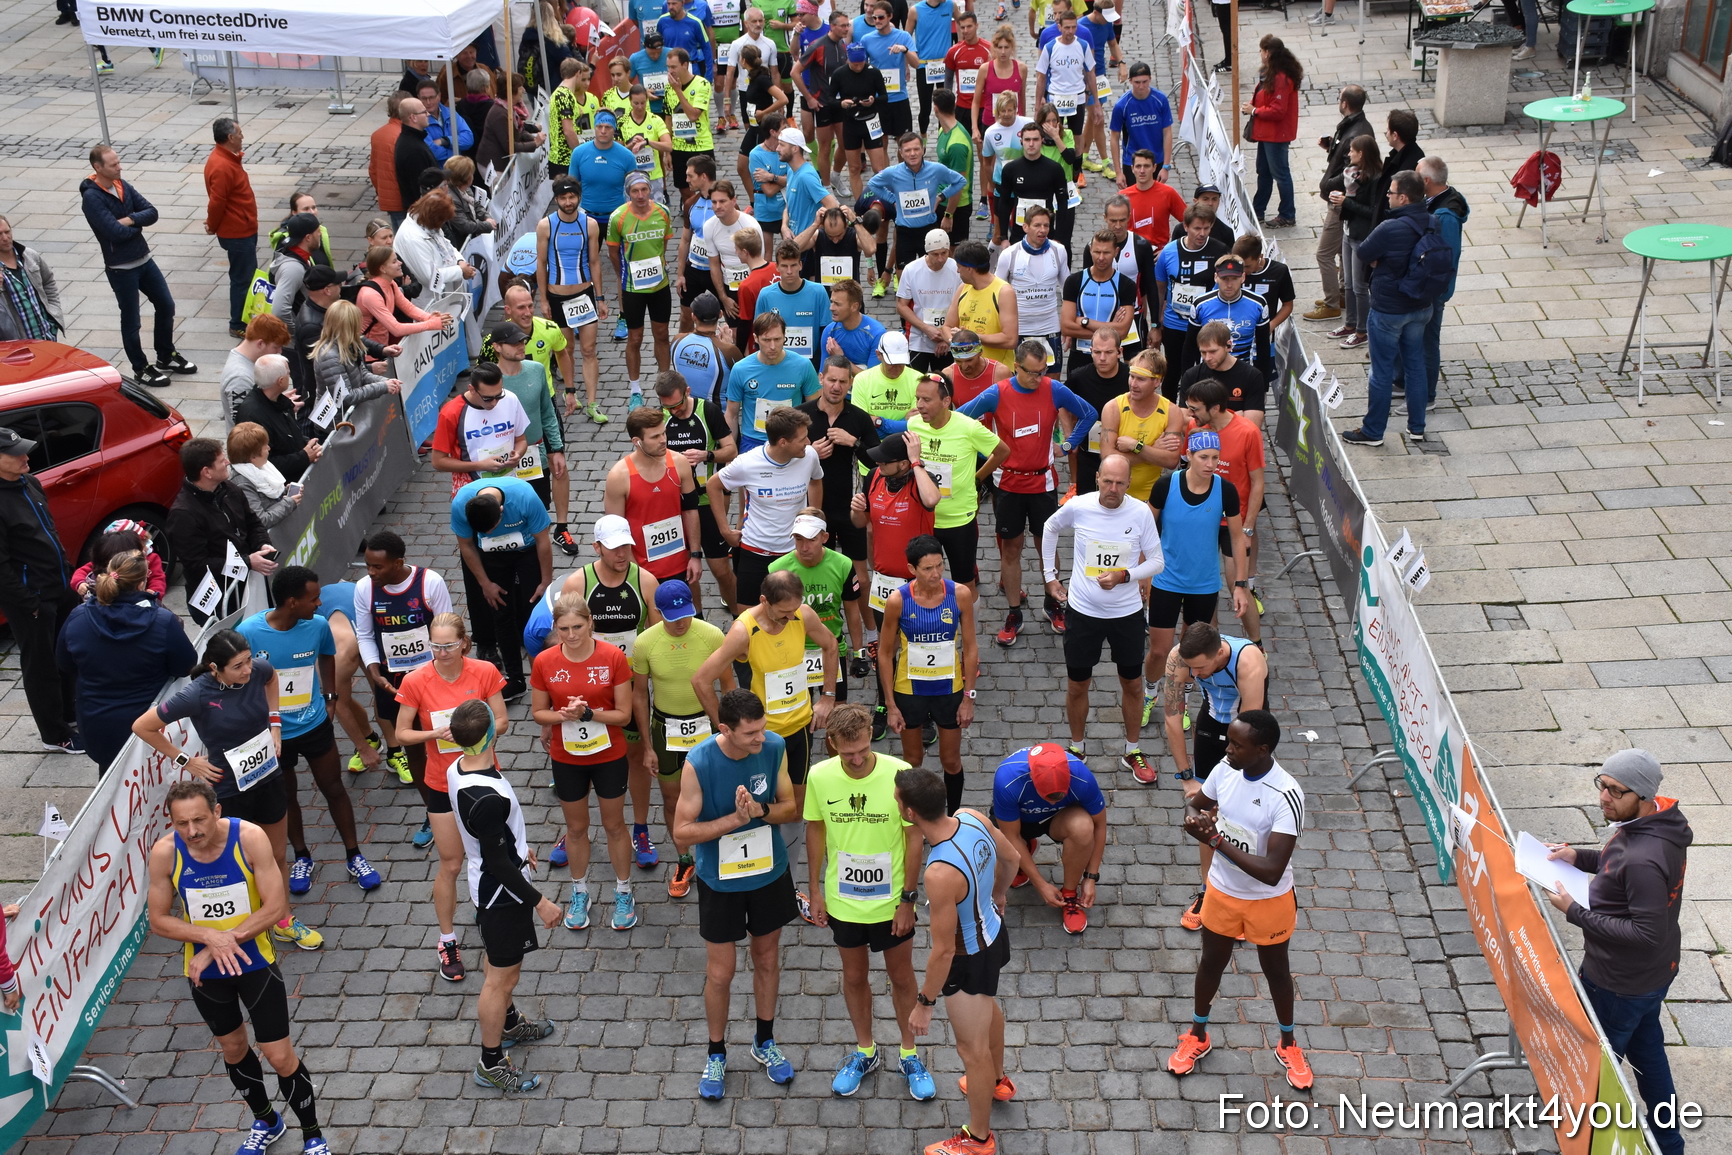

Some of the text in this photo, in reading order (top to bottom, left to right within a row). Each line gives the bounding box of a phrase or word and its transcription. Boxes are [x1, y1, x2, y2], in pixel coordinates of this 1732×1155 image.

[96, 6, 289, 30] BMW ConnectedDrive
[99, 25, 247, 42] Vernetzt, um frei zu sein.
[1056, 55, 1079, 68] SUSPA
[525, 55, 534, 87] adidas
[648, 82, 665, 91] 2381
[883, 76, 892, 84] 97
[962, 76, 976, 84] 258
[1056, 99, 1075, 108] 2446
[675, 121, 693, 129] 2690
[1131, 114, 1157, 124] SYSCAD
[636, 155, 651, 164] 686
[904, 197, 926, 209] 2024
[625, 228, 665, 243] BOCK
[636, 266, 658, 278] 2785
[732, 270, 749, 281] 278
[831, 265, 842, 275] 10
[1177, 292, 1193, 304] 254
[567, 303, 590, 317] 2709
[783, 336, 807, 347] 2735
[1307, 367, 1319, 383] sw
[317, 404, 330, 422] swn
[1289, 371, 1309, 449] BOK
[465, 418, 515, 441] RÖDL
[667, 438, 703, 446] Röthenbach
[934, 473, 943, 486] 2
[287, 519, 318, 567] OCK
[650, 527, 678, 546] 2915
[1095, 554, 1120, 566] 187
[1393, 545, 1404, 562] sw
[1409, 559, 1426, 586] swn
[805, 583, 828, 593] ÜRTH
[199, 586, 214, 607] swn
[801, 592, 834, 605] 2014
[375, 613, 425, 626] MENSCH
[592, 613, 636, 621] Röthenbach
[913, 631, 949, 642] HEITEC
[292, 650, 315, 659] BOCK
[390, 640, 425, 657] 2645
[926, 654, 936, 666] 2
[285, 680, 294, 694] 4
[785, 681, 794, 695] 5
[578, 726, 589, 740] 3
[680, 721, 697, 736] 65
[574, 739, 598, 750] Stephanie
[239, 745, 269, 774] 2997
[740, 843, 748, 858] 1
[737, 861, 756, 870] Stefan
[844, 866, 884, 883] 2000
[853, 886, 876, 894] Michael
[202, 900, 236, 918] 293
[1508, 929, 1517, 948] für
[1515, 945, 1524, 962] die
[1517, 925, 1540, 974] Neumarkts
[84, 943, 135, 1027] Service-Line:
